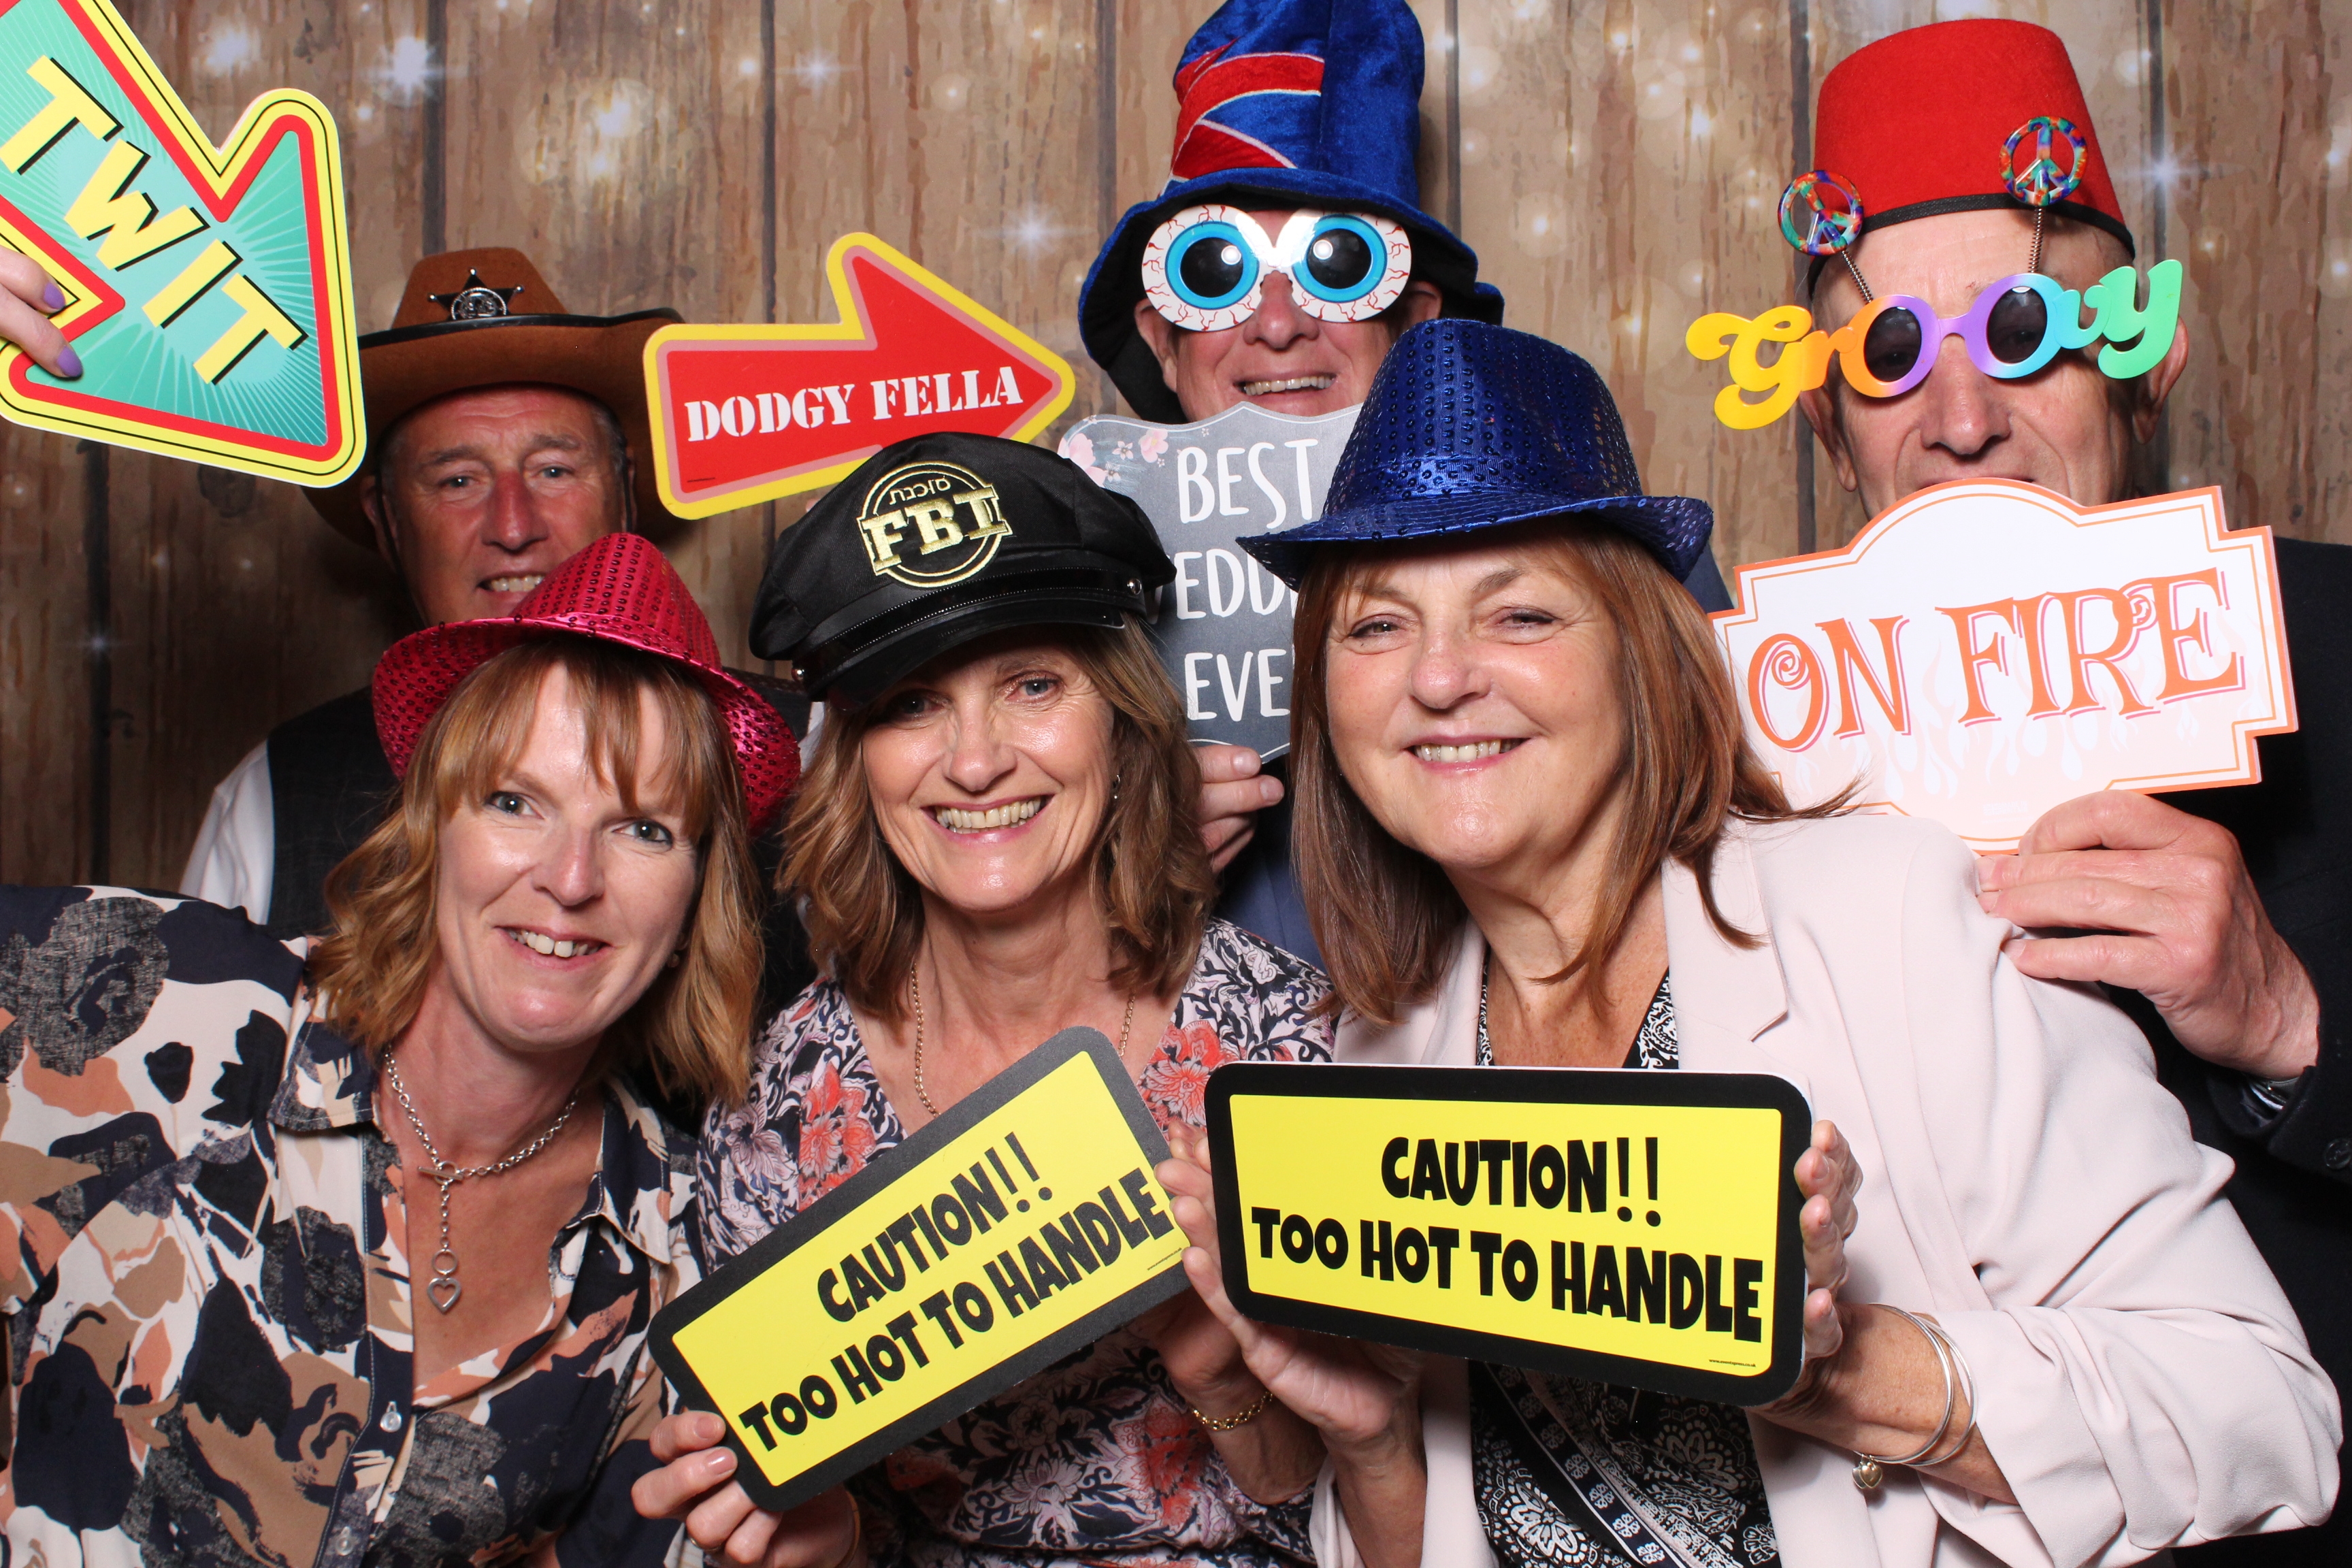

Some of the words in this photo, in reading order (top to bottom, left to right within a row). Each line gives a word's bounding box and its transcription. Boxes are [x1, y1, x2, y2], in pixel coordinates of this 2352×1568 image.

[0, 55, 308, 385] TWIT
[685, 384, 855, 442] DODGY
[870, 367, 1023, 421] FELLA
[1177, 439, 1318, 529] BEST
[859, 486, 1009, 573] FBI
[1145, 549, 1298, 625] EDD
[1184, 647, 1294, 722] EVE
[1748, 615, 1912, 753] ON
[1934, 567, 2246, 727] FIRE
[817, 1132, 1054, 1322] CAUTION!!
[1381, 1137, 1661, 1227] CAUTION!!
[738, 1374, 837, 1452] TOO
[830, 1311, 930, 1405] HOT
[919, 1281, 994, 1349] TO
[983, 1168, 1174, 1318] HANDLE
[1252, 1207, 1349, 1269] TOO
[1360, 1220, 1459, 1289] HOT
[1470, 1231, 1539, 1302] TO
[1551, 1240, 1763, 1343] HANDLE
